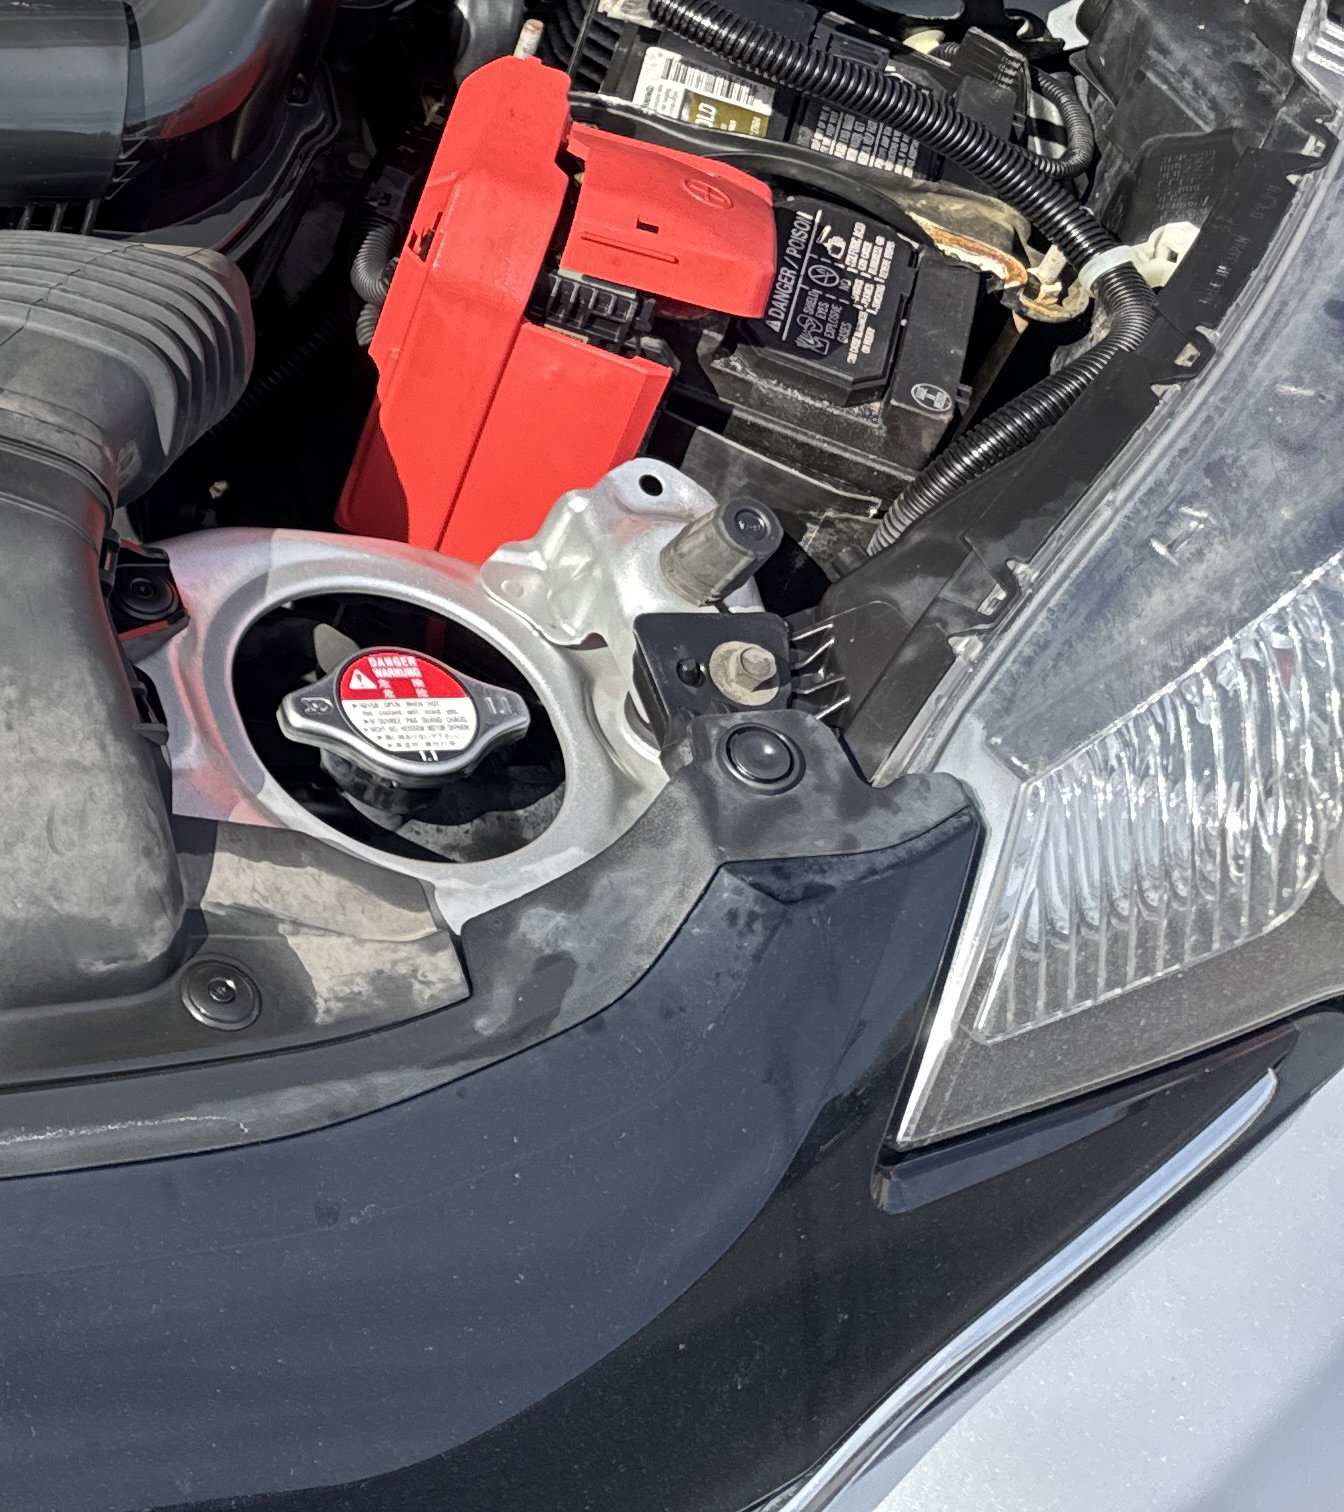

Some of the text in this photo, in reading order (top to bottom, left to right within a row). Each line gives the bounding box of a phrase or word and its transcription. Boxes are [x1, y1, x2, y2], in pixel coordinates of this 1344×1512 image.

[772, 266, 798, 322] DANGER
[785, 210, 814, 259] POISON
[367, 655, 418, 668] DANGER
